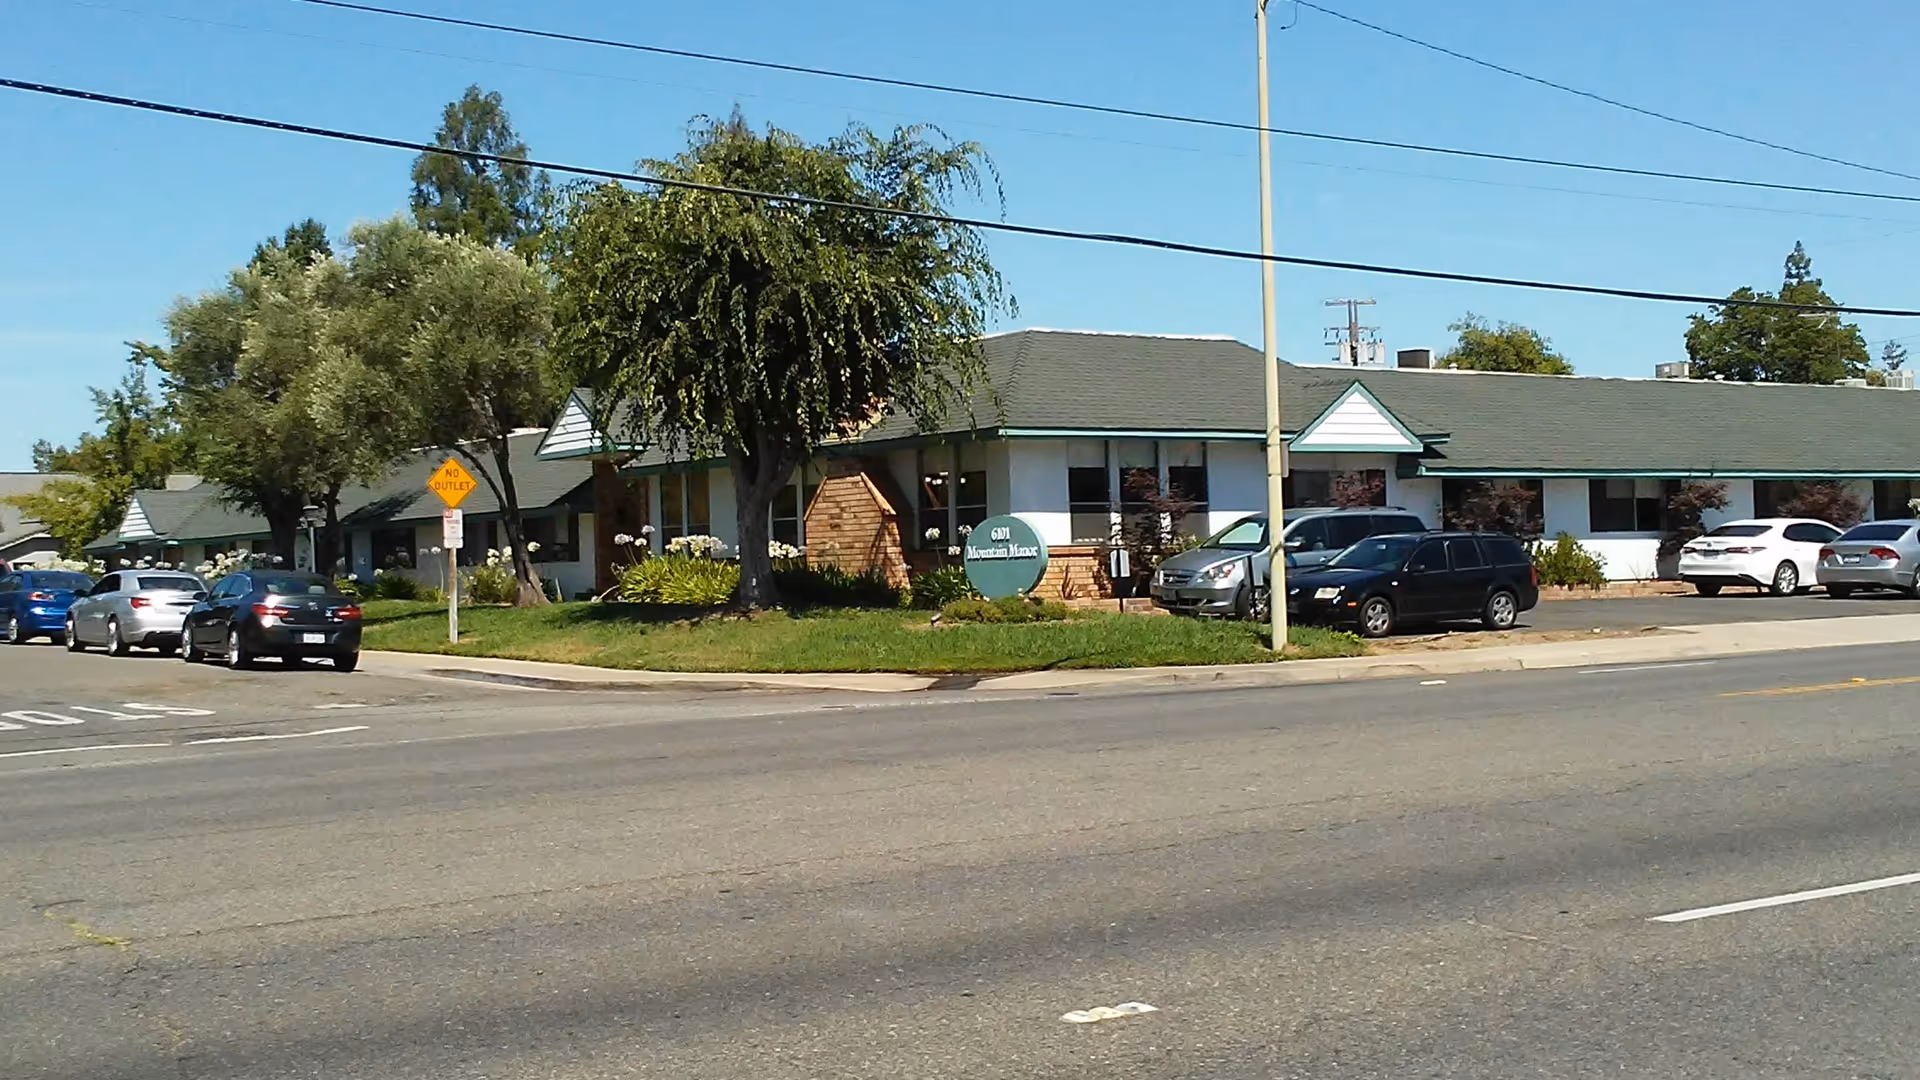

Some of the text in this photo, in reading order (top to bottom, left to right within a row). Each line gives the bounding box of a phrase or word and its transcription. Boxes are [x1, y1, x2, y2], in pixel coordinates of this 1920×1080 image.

[445, 468, 460, 478] NO
[434, 481, 471, 491] OUTLET
[990, 526, 1011, 541] 6101
[967, 543, 1039, 559] Mountain Manor
